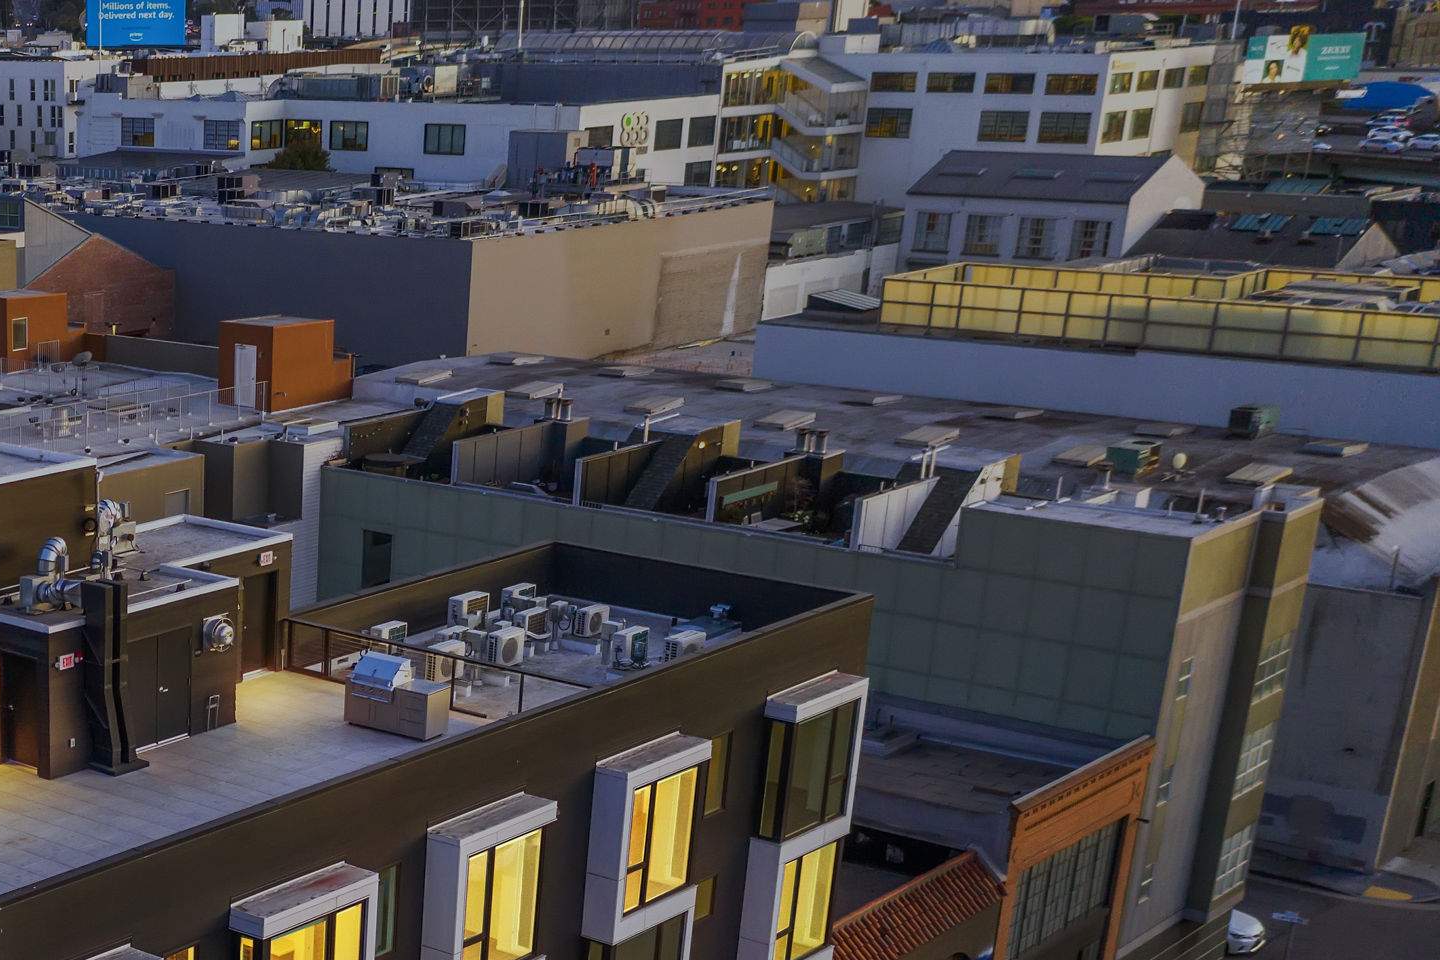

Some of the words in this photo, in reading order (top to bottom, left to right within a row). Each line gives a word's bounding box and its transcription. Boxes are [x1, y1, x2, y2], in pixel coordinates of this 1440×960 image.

[102, 2, 134, 10] Millions
[136, 2, 144, 10] of
[146, 2, 171, 10] items.
[98, 11, 137, 20] Delivered
[138, 11, 156, 19] next
[158, 11, 175, 20] day.
